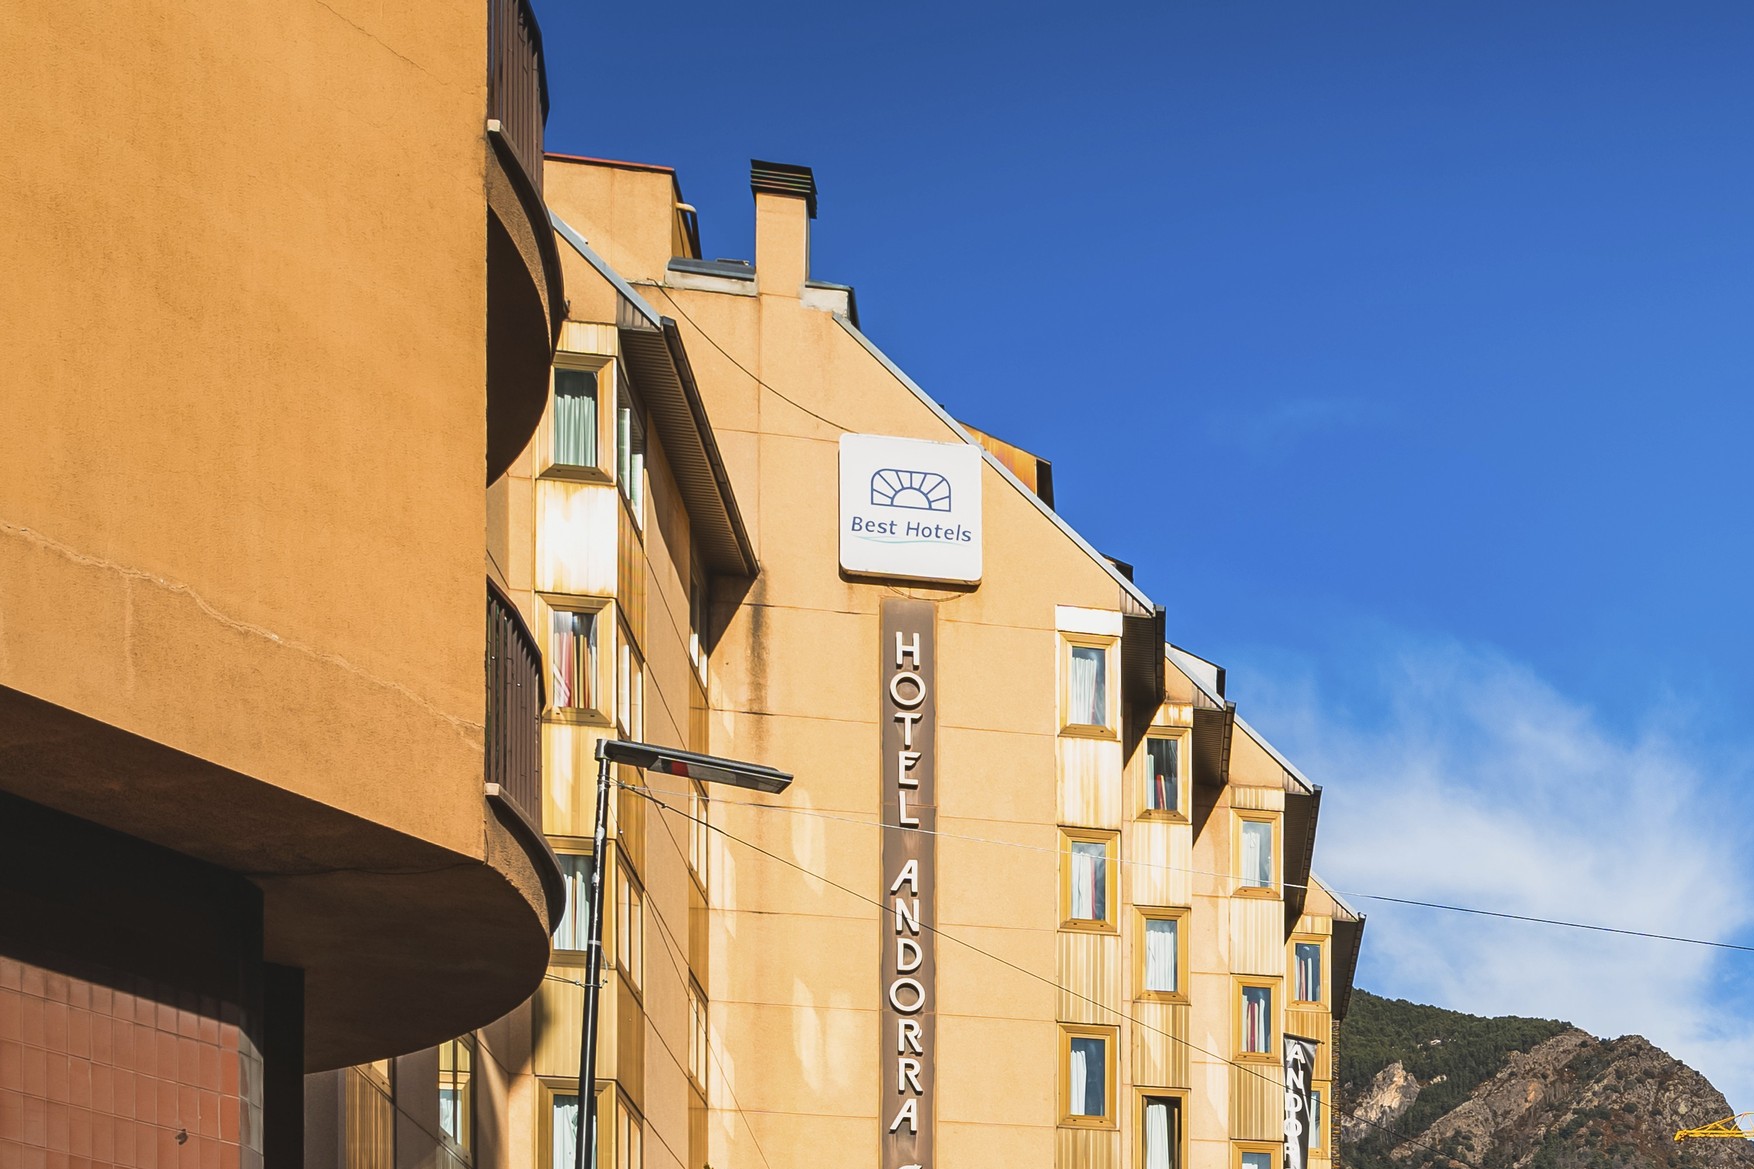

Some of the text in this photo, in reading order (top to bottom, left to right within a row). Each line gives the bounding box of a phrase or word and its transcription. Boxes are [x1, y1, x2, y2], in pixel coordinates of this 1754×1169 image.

[850, 516, 972, 542] Best Hotels
[889, 631, 926, 829] HOTEL
[889, 858, 926, 1134] ANDORRA
